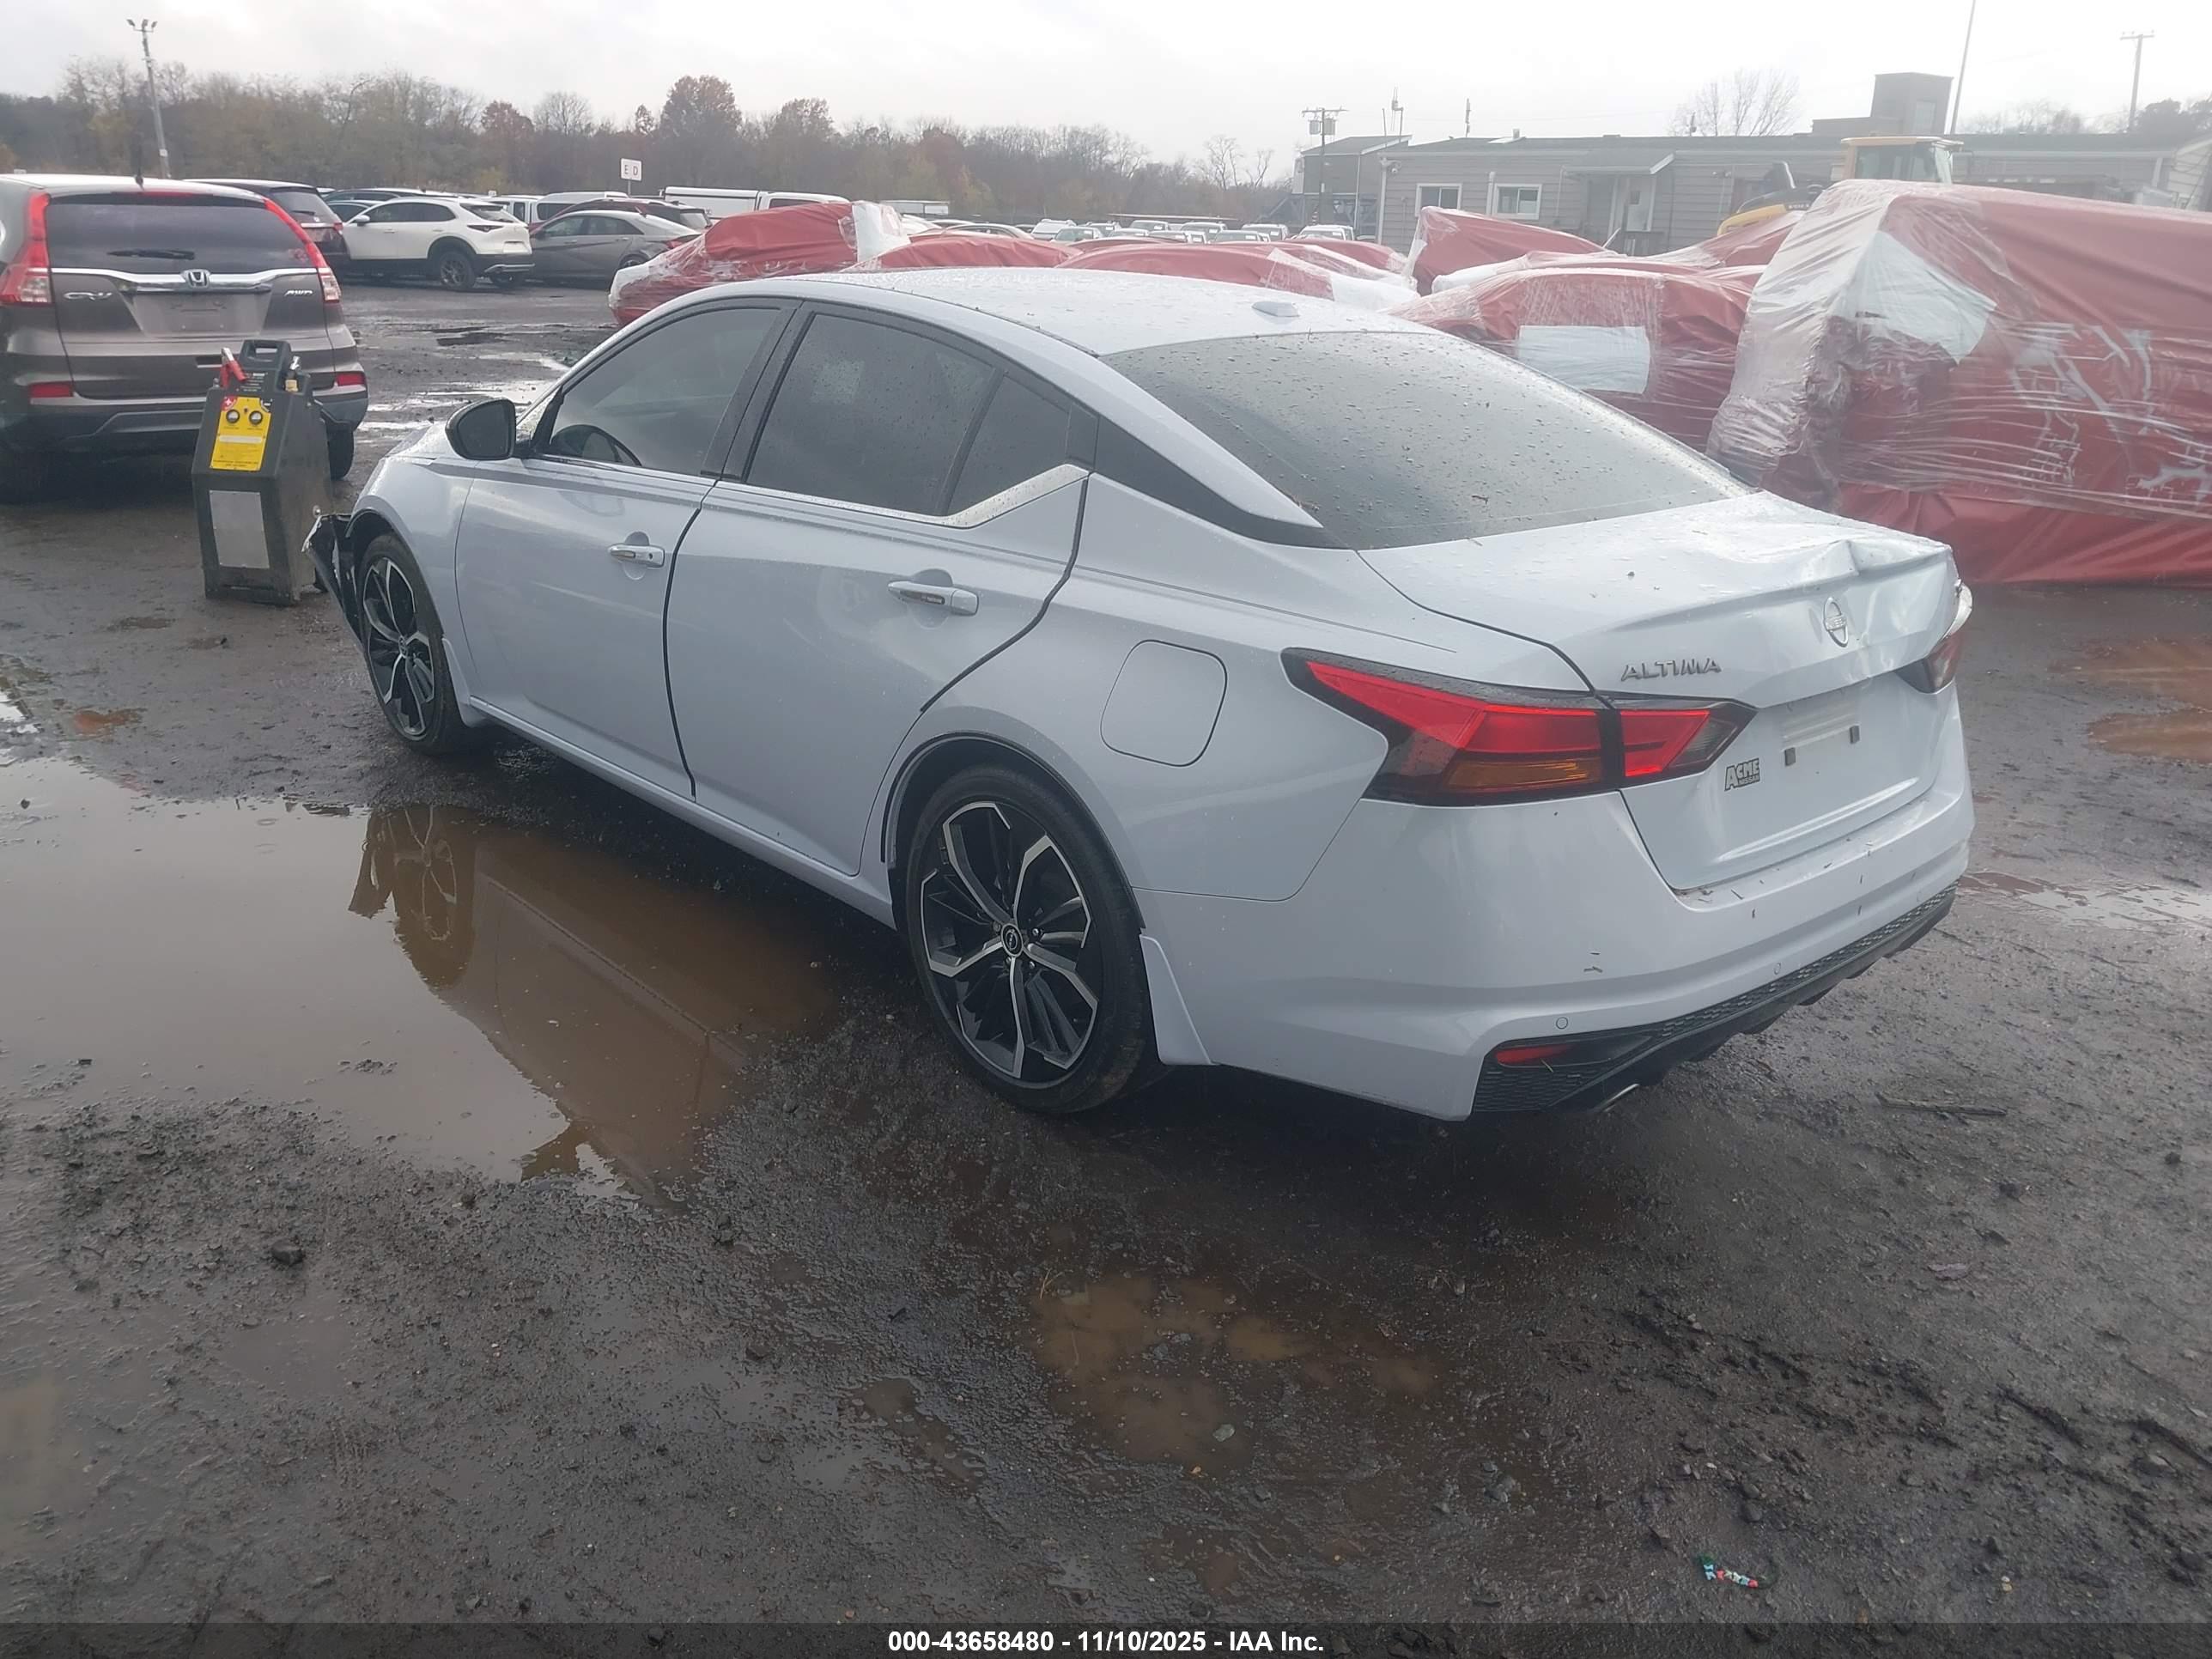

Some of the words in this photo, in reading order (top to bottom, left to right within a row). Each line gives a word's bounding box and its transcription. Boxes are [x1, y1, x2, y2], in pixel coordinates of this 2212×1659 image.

[633, 165, 639, 176] D
[1620, 658, 1723, 682] ALTIMA
[1724, 757, 1760, 791] ACME
